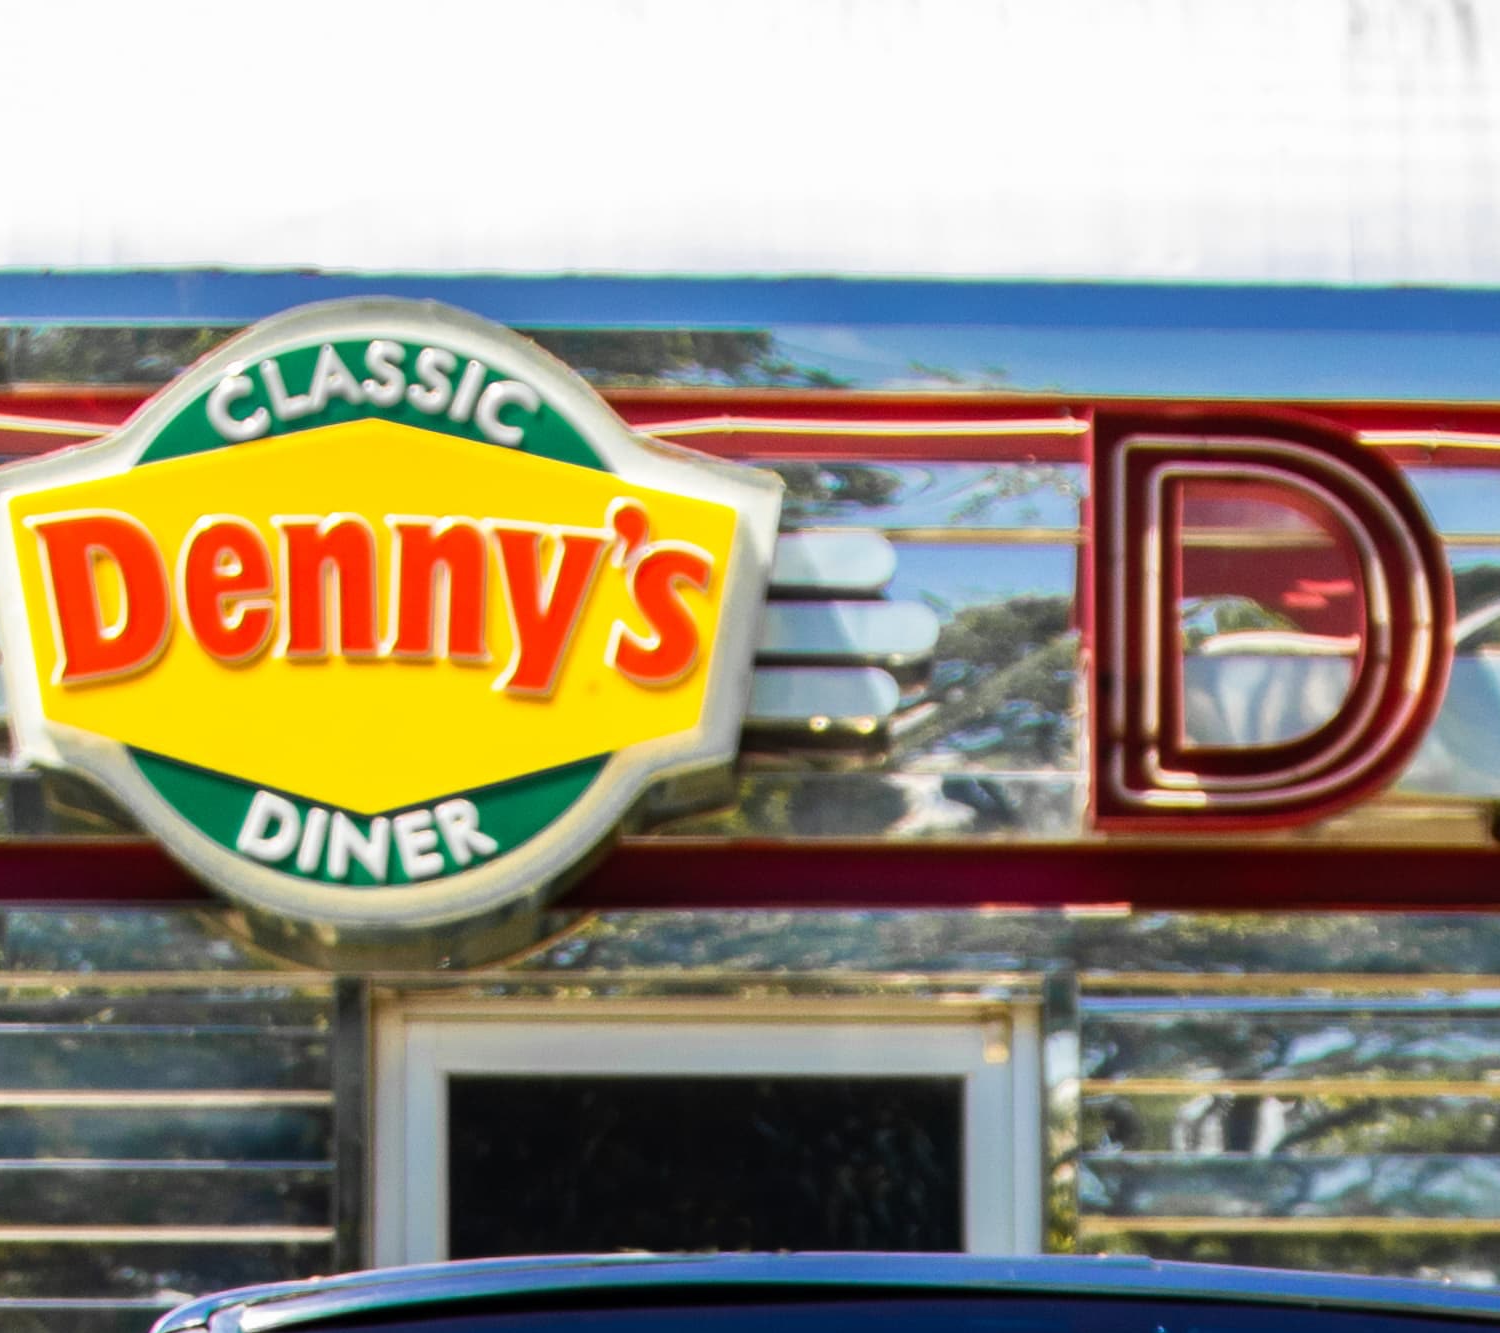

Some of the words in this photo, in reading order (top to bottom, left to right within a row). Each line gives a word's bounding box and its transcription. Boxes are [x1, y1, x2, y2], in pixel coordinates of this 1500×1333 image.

[205, 339, 541, 446] CLASSIC
[23, 496, 715, 698] Denny's
[236, 789, 499, 884] DINER
